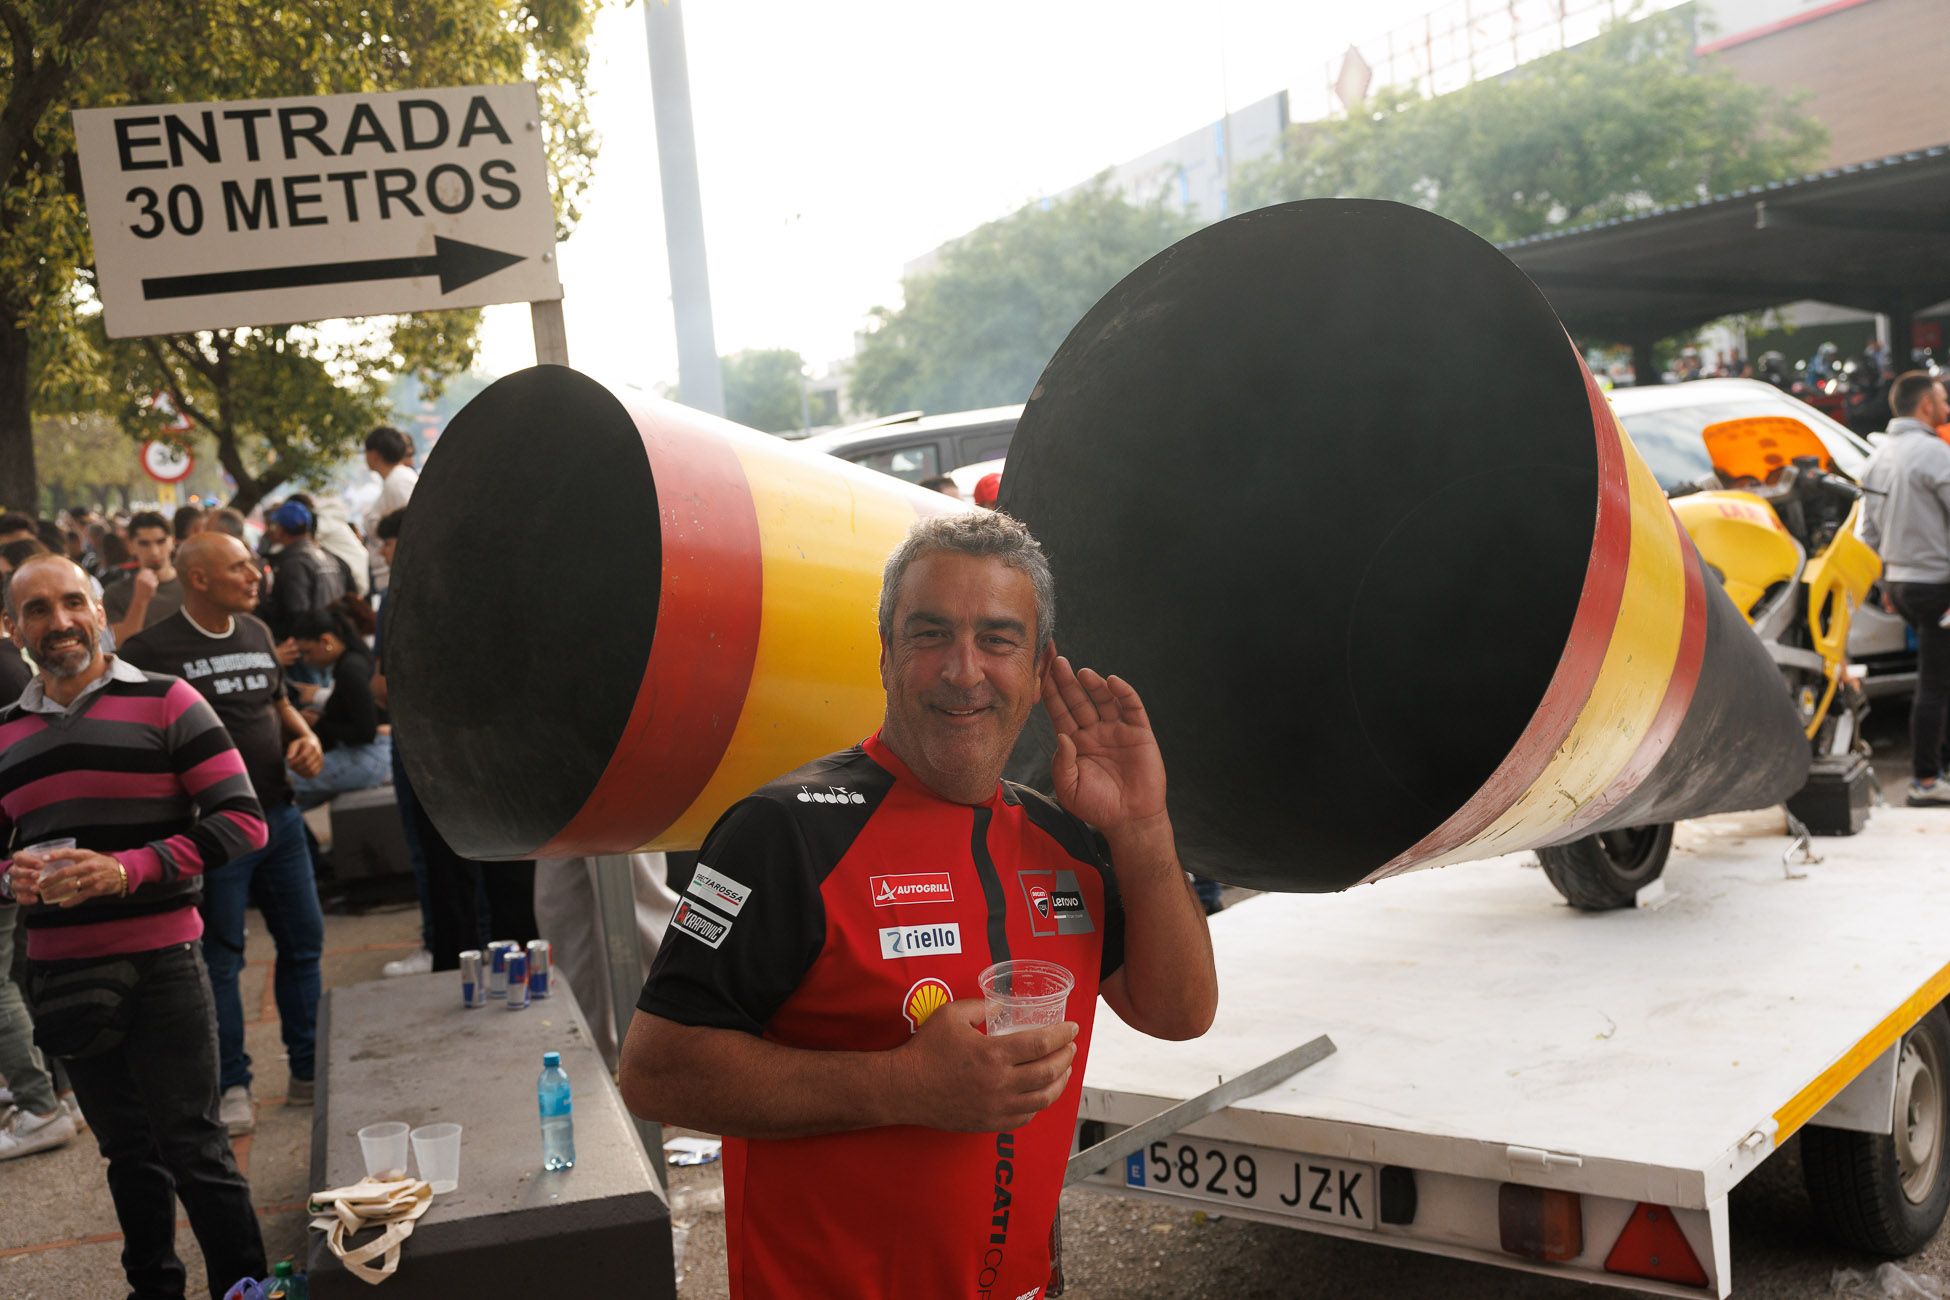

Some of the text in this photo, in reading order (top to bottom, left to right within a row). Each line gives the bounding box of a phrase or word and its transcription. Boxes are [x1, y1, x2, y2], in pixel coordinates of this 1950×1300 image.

[113, 95, 512, 171] ENTRADA
[125, 159, 521, 239] 30 METROS
[797, 785, 866, 805] diadora
[897, 883, 949, 895] AUTOGRILL
[1051, 895, 1079, 907] Lenovo
[906, 927, 955, 949] riello
[1131, 1164, 1141, 1178] E
[1150, 1141, 1363, 1220] 5829 JZK
[990, 1133, 1014, 1244] UCATI
